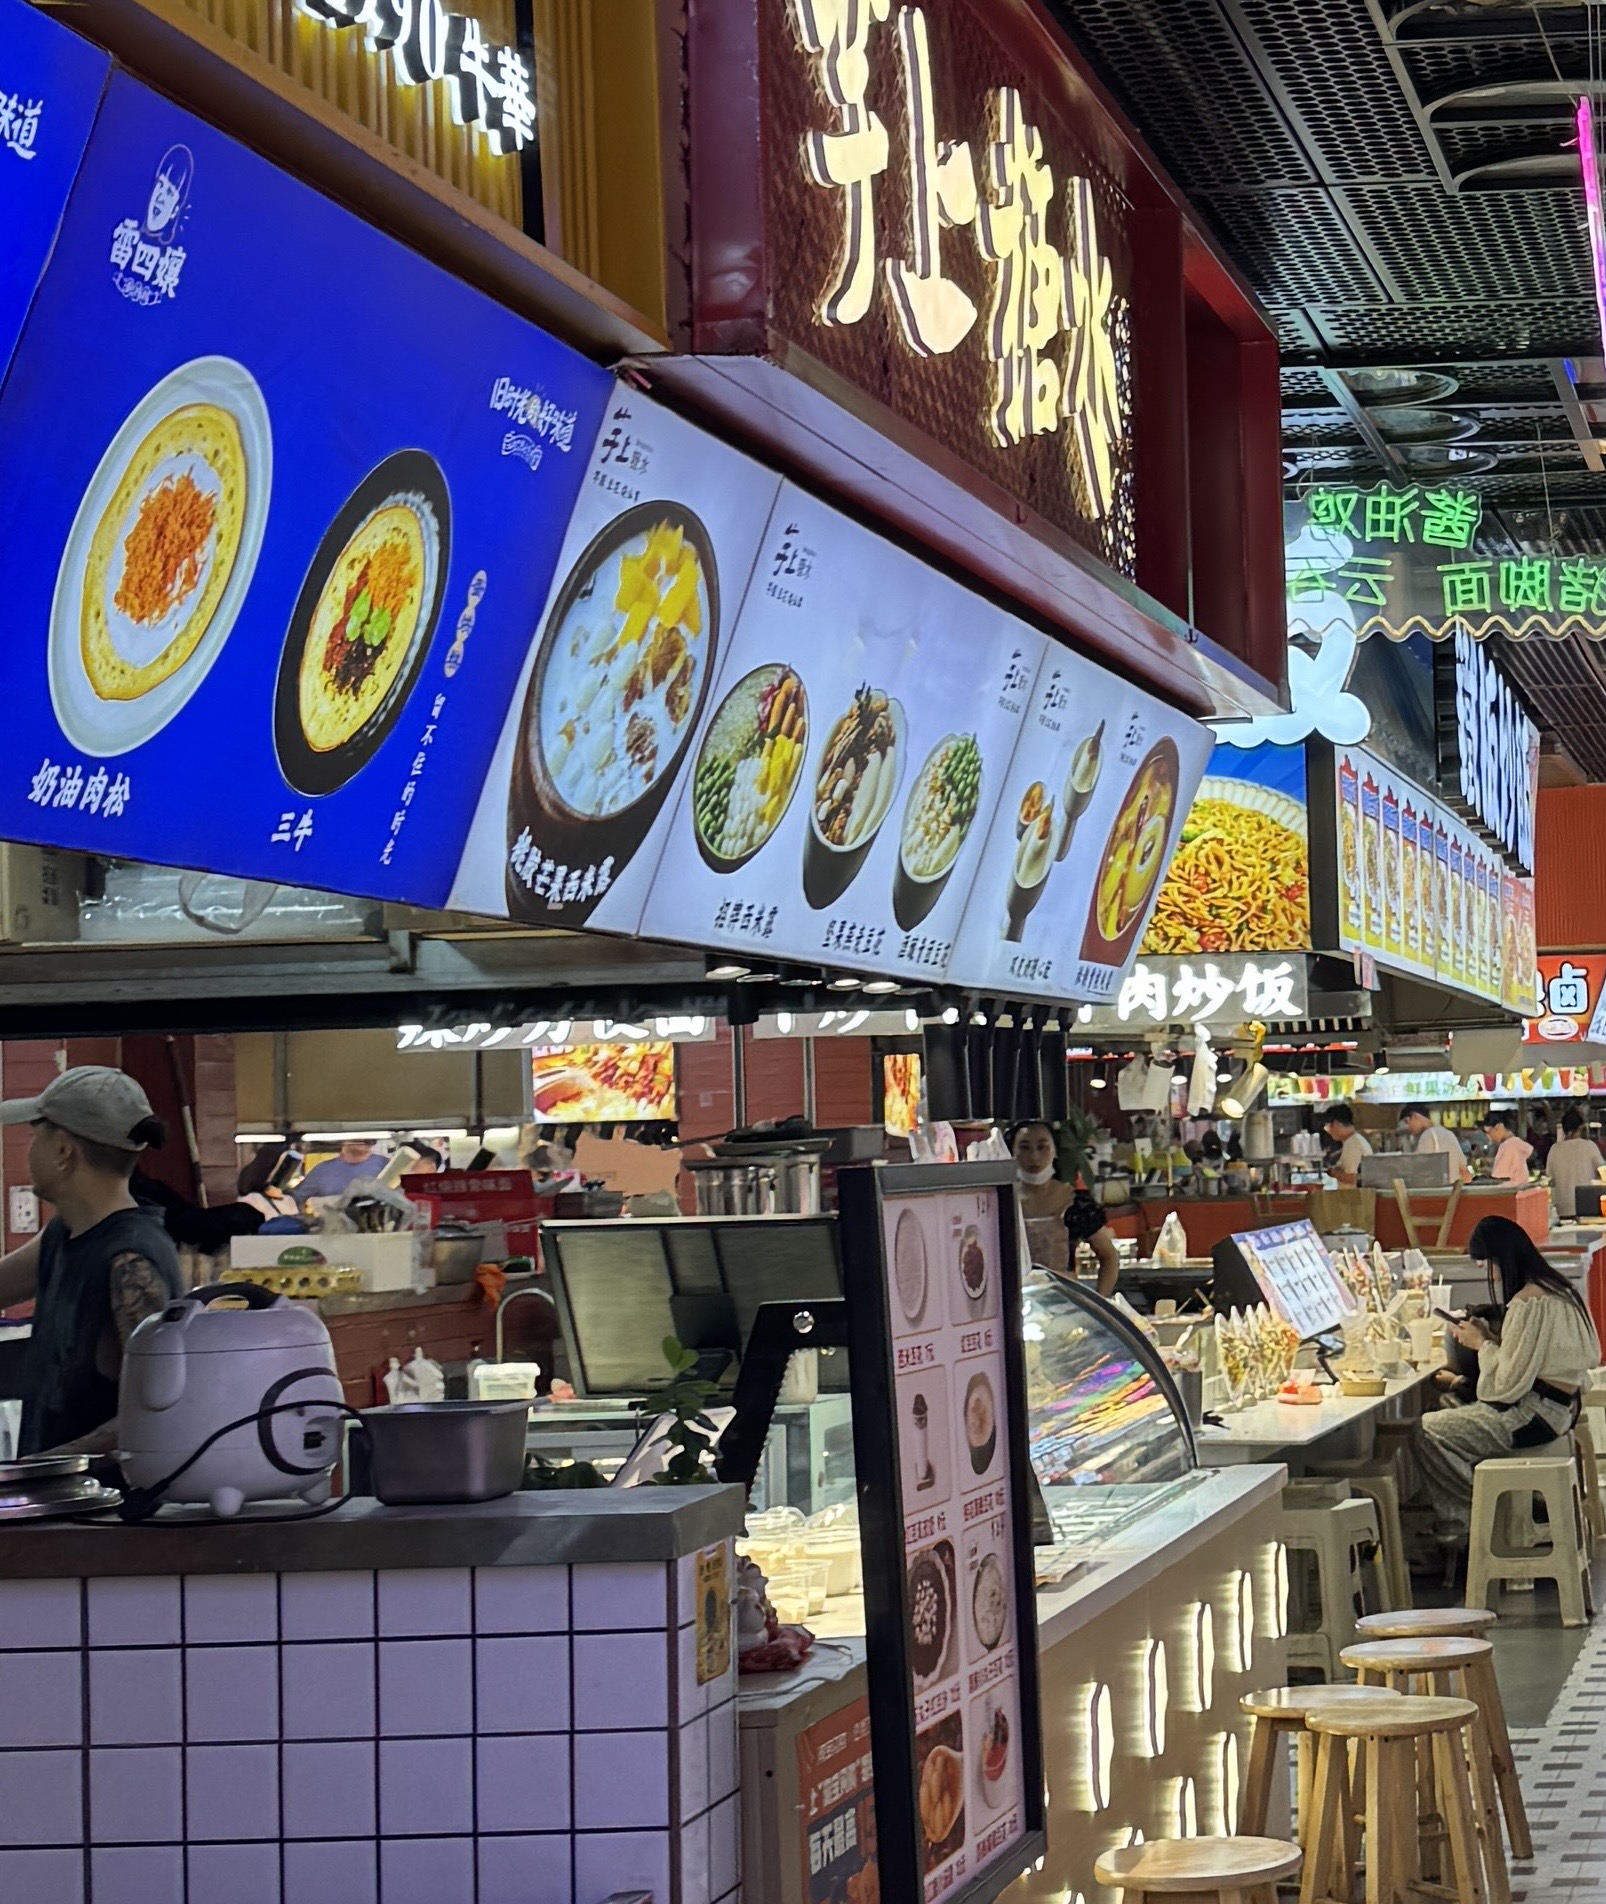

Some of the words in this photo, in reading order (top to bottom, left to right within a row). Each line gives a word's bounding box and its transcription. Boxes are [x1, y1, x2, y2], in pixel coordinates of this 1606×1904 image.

[27, 758, 131, 818] 奶油肉松
[1078, 961, 1303, 1023] 肉炒饭
